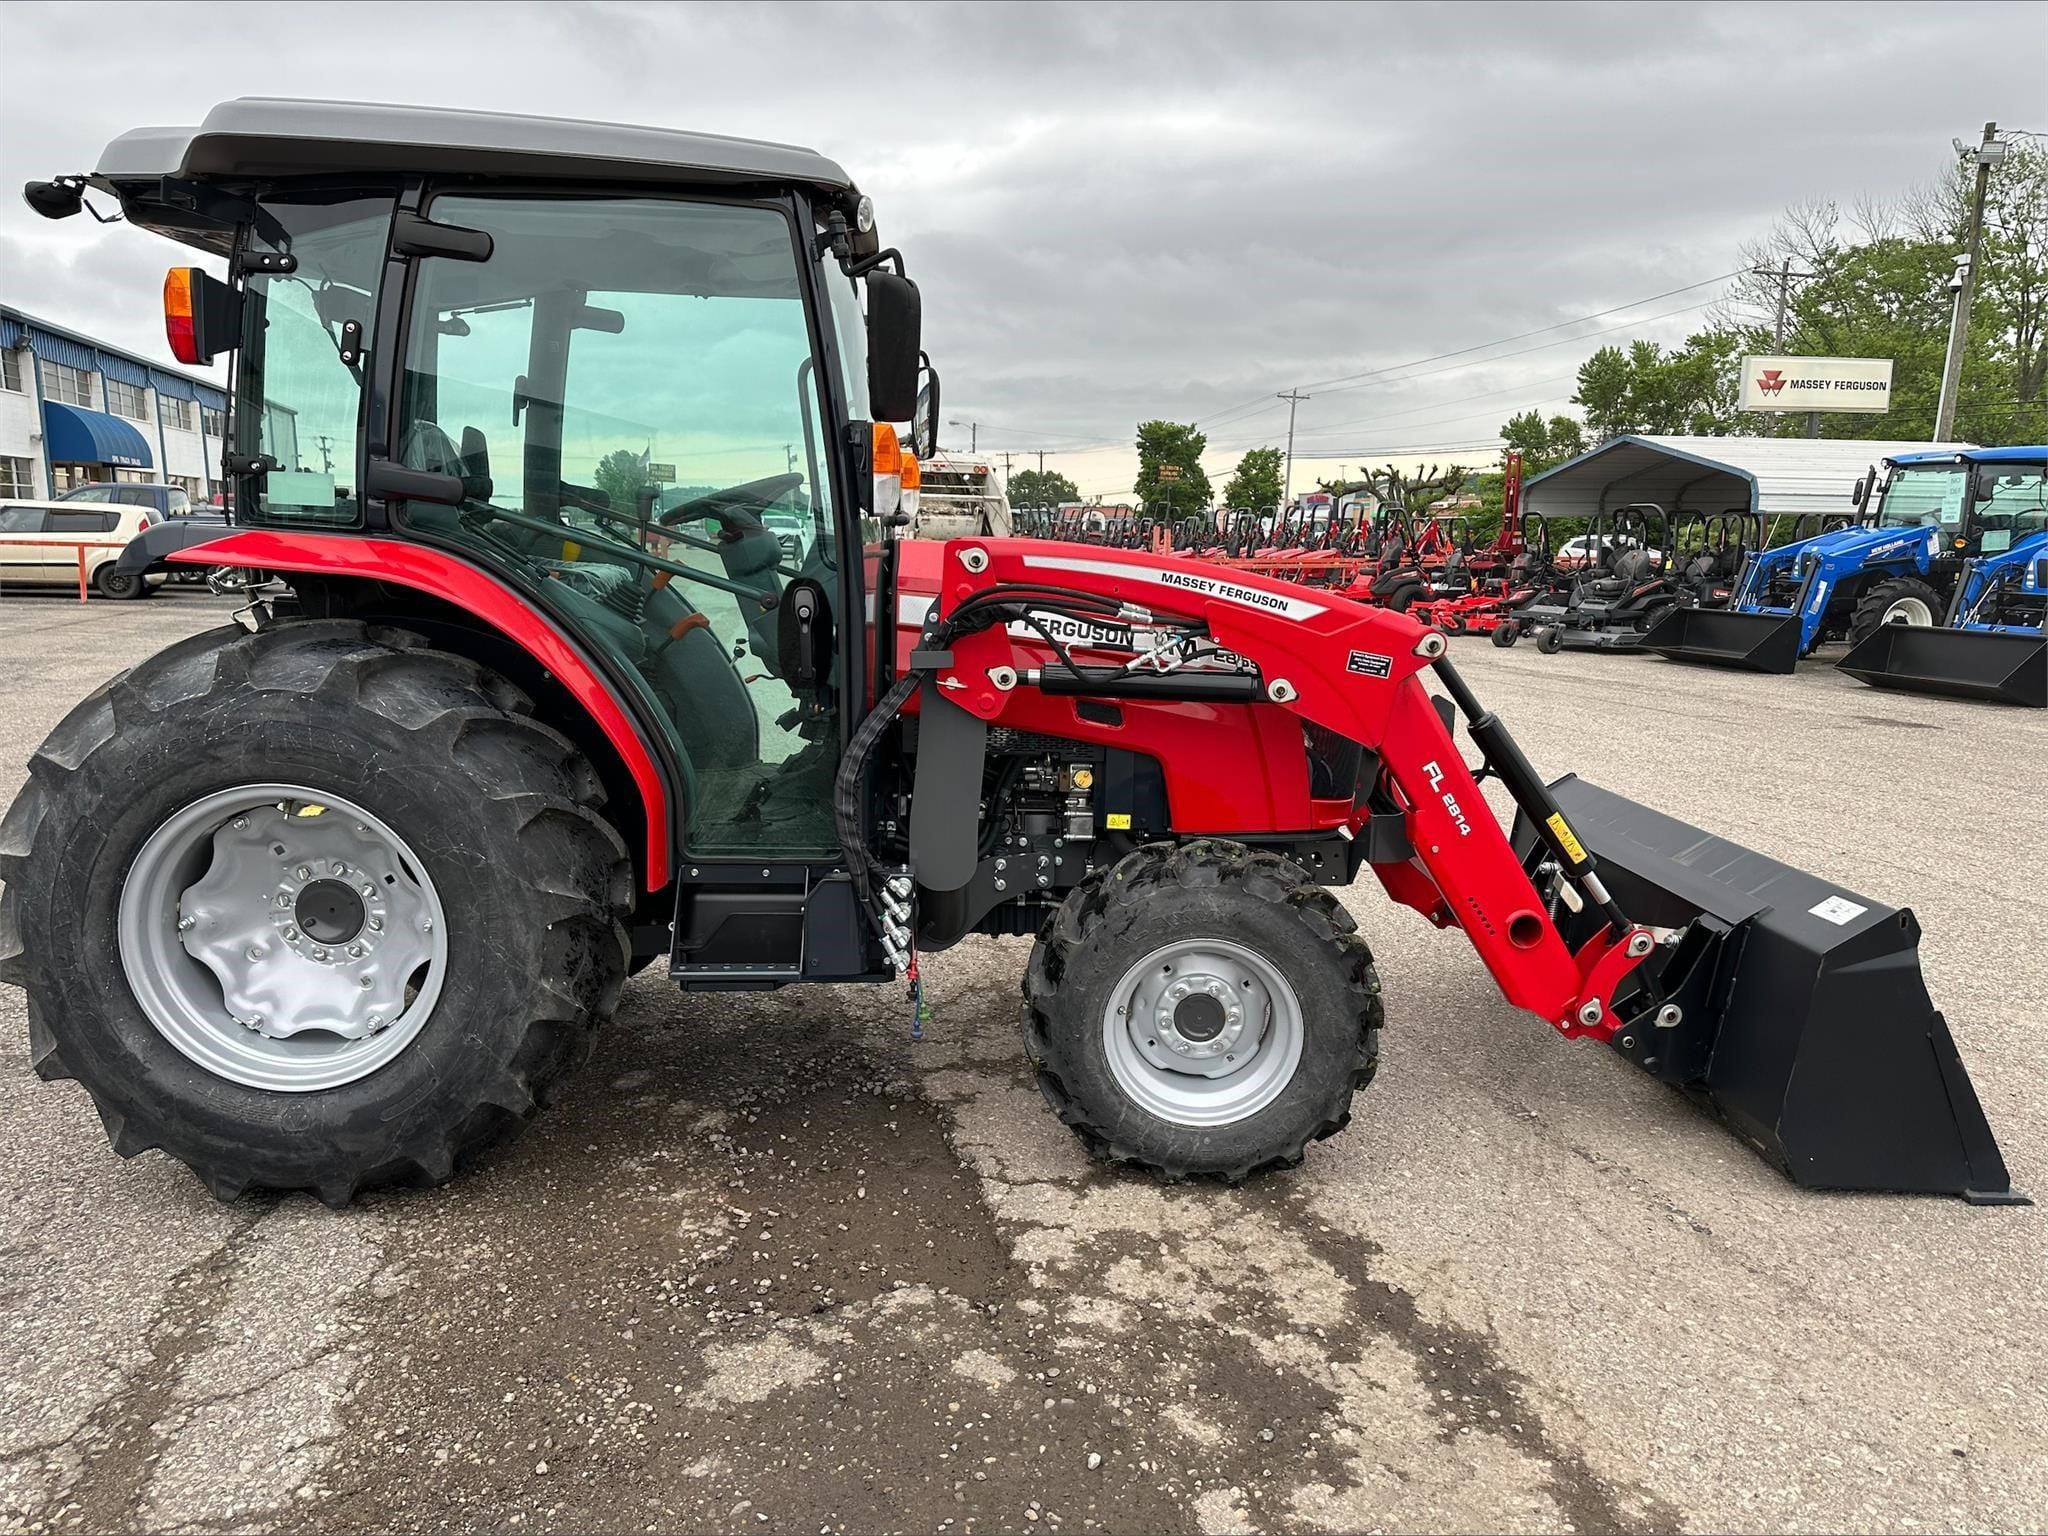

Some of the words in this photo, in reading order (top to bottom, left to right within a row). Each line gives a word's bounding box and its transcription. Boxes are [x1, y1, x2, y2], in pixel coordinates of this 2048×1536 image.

[1790, 379, 1831, 389] MASSEY
[1834, 380, 1887, 391] FERGUSON
[1161, 573, 1215, 592] MASSEY
[1219, 586, 1288, 611] FERGUSON
[1422, 760, 1444, 793] FL
[1441, 792, 1471, 836] 2814
